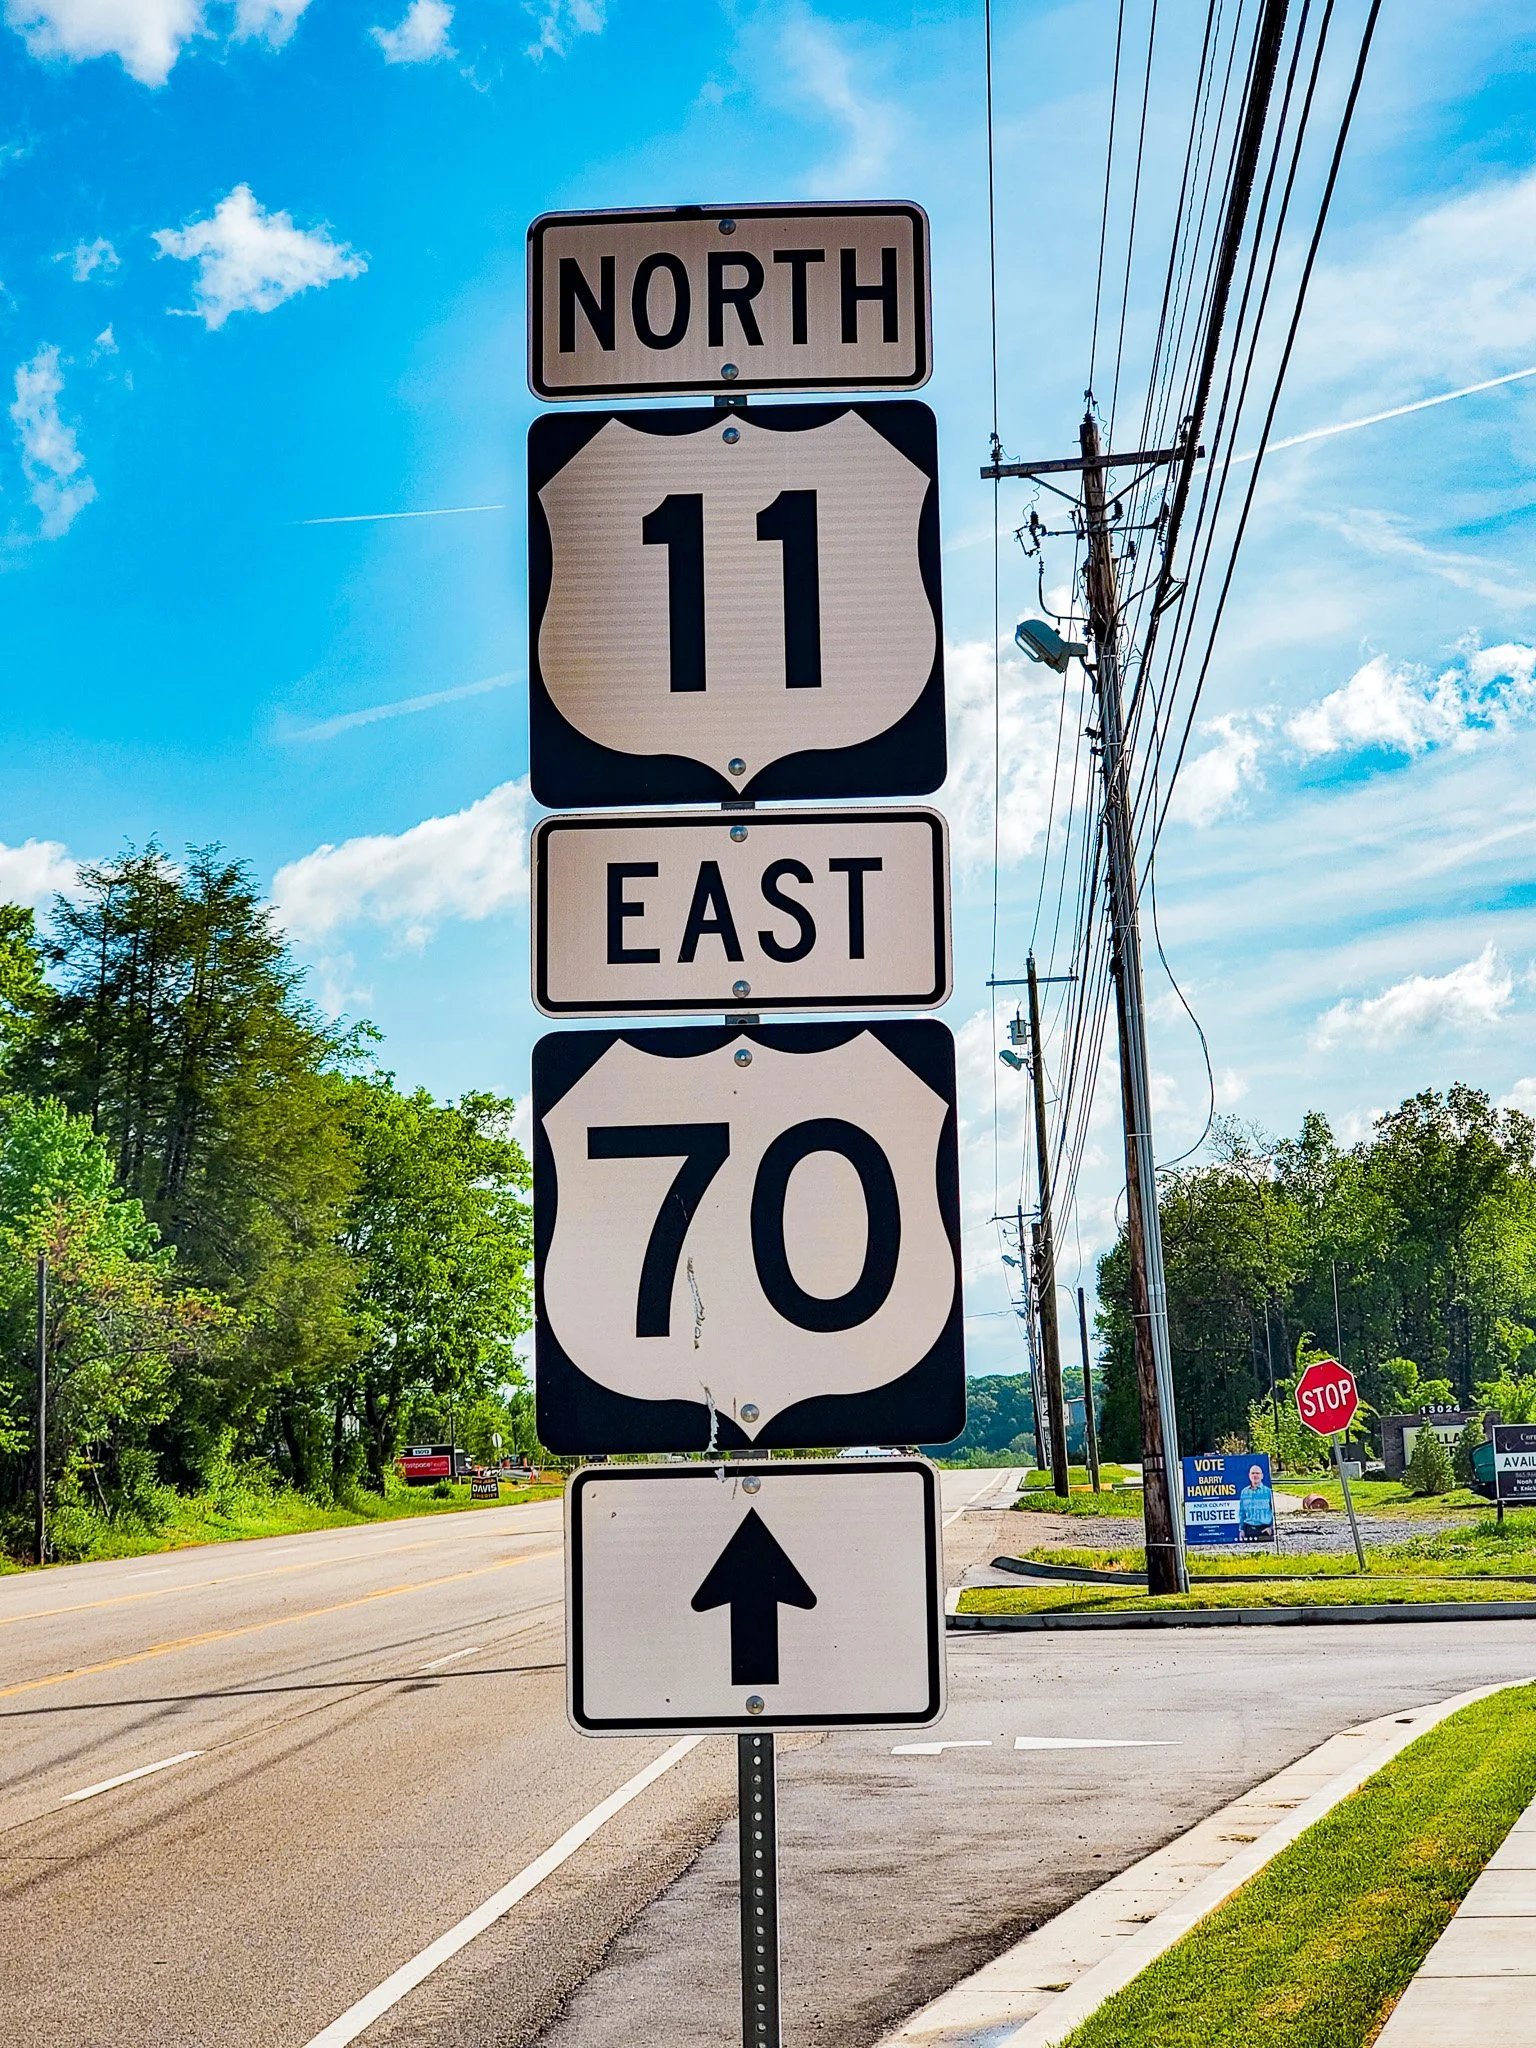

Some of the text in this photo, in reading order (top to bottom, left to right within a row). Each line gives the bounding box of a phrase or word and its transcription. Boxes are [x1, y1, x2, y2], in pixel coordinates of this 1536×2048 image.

[558, 247, 899, 354] NORTH
[641, 489, 822, 694] 11
[606, 857, 884, 966] EAST
[586, 1117, 902, 1339] 70
[1301, 1379, 1352, 1417] STOP
[1421, 1404, 1460, 1414] 13024
[1194, 1459, 1225, 1472] VOTE
[1198, 1476, 1223, 1484] BARRY
[472, 1483, 497, 1493] DAVIS
[1187, 1484, 1236, 1496] HAWKINS
[1189, 1509, 1236, 1521] TRUSTEE
